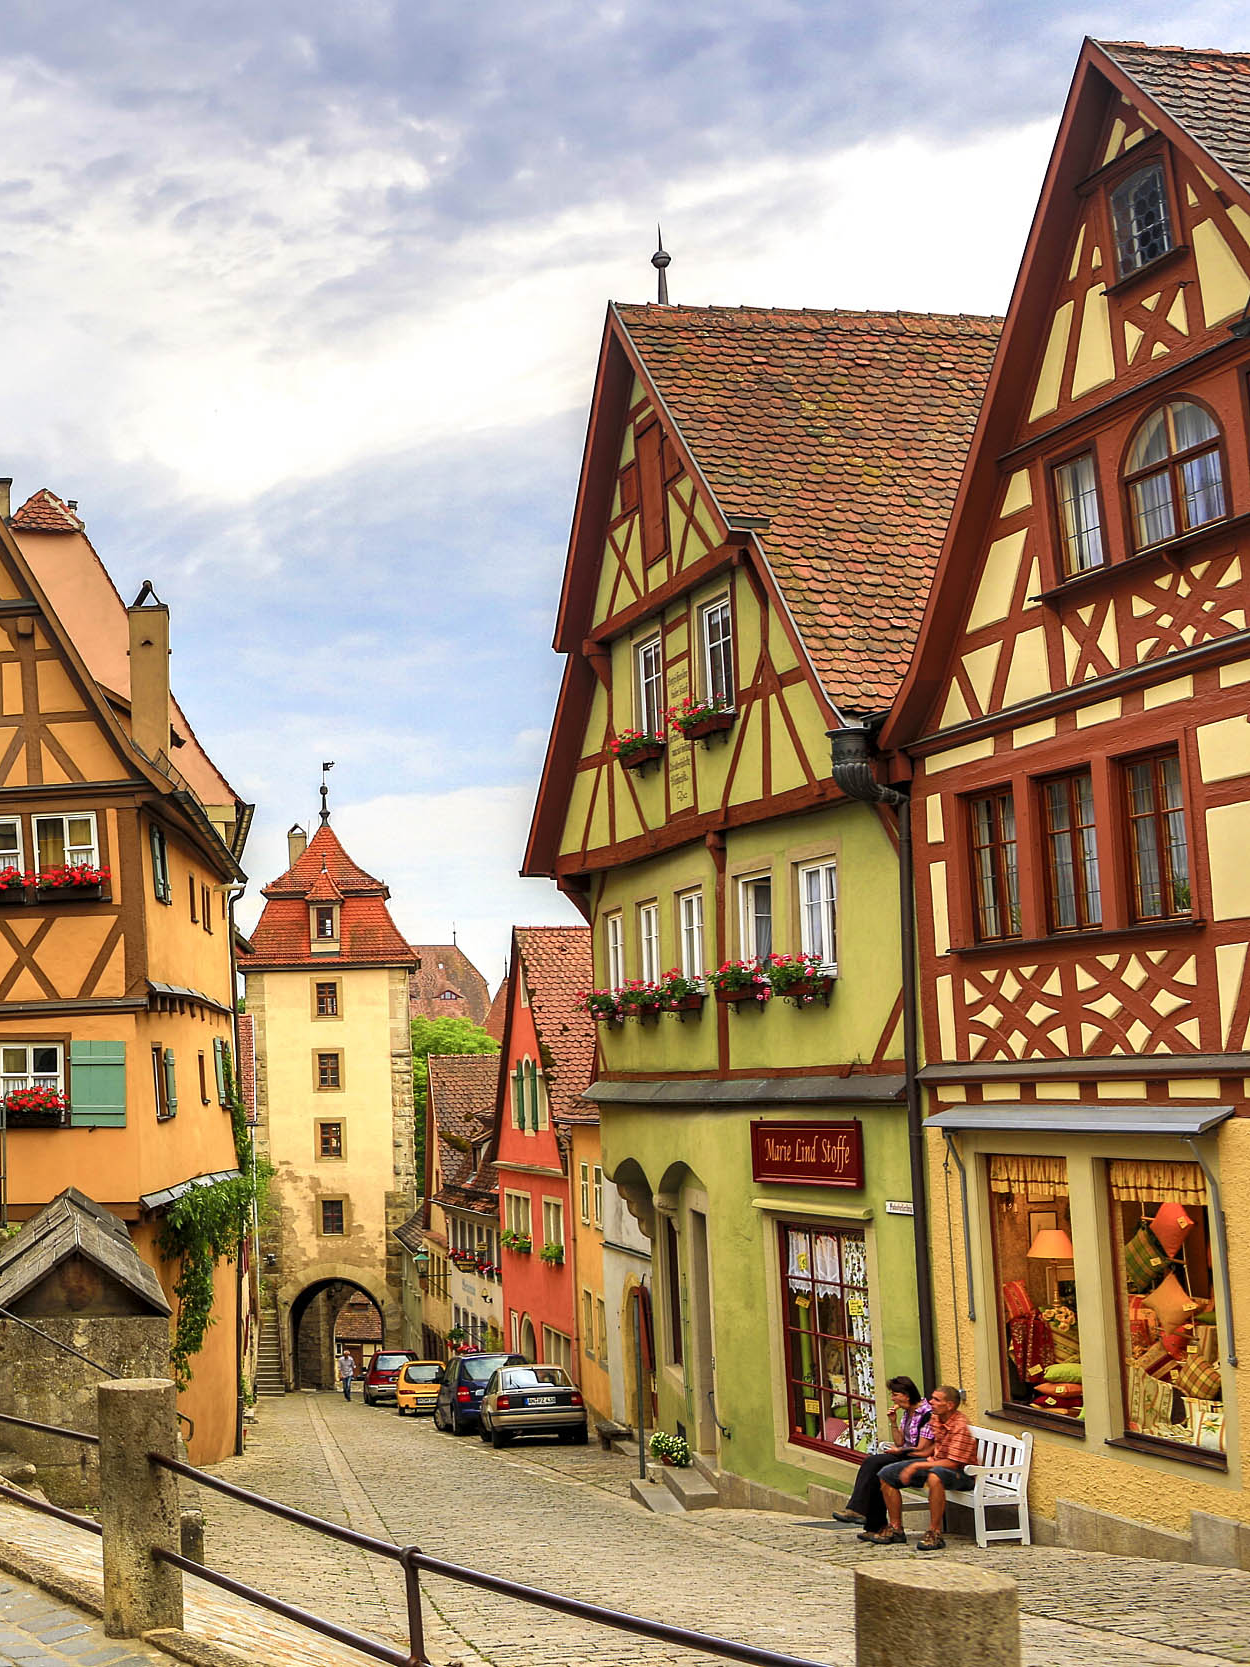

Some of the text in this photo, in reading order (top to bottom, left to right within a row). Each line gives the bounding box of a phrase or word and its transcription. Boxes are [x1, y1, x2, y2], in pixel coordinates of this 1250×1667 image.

[765, 1135, 850, 1173] Marie Lind Stoffe
